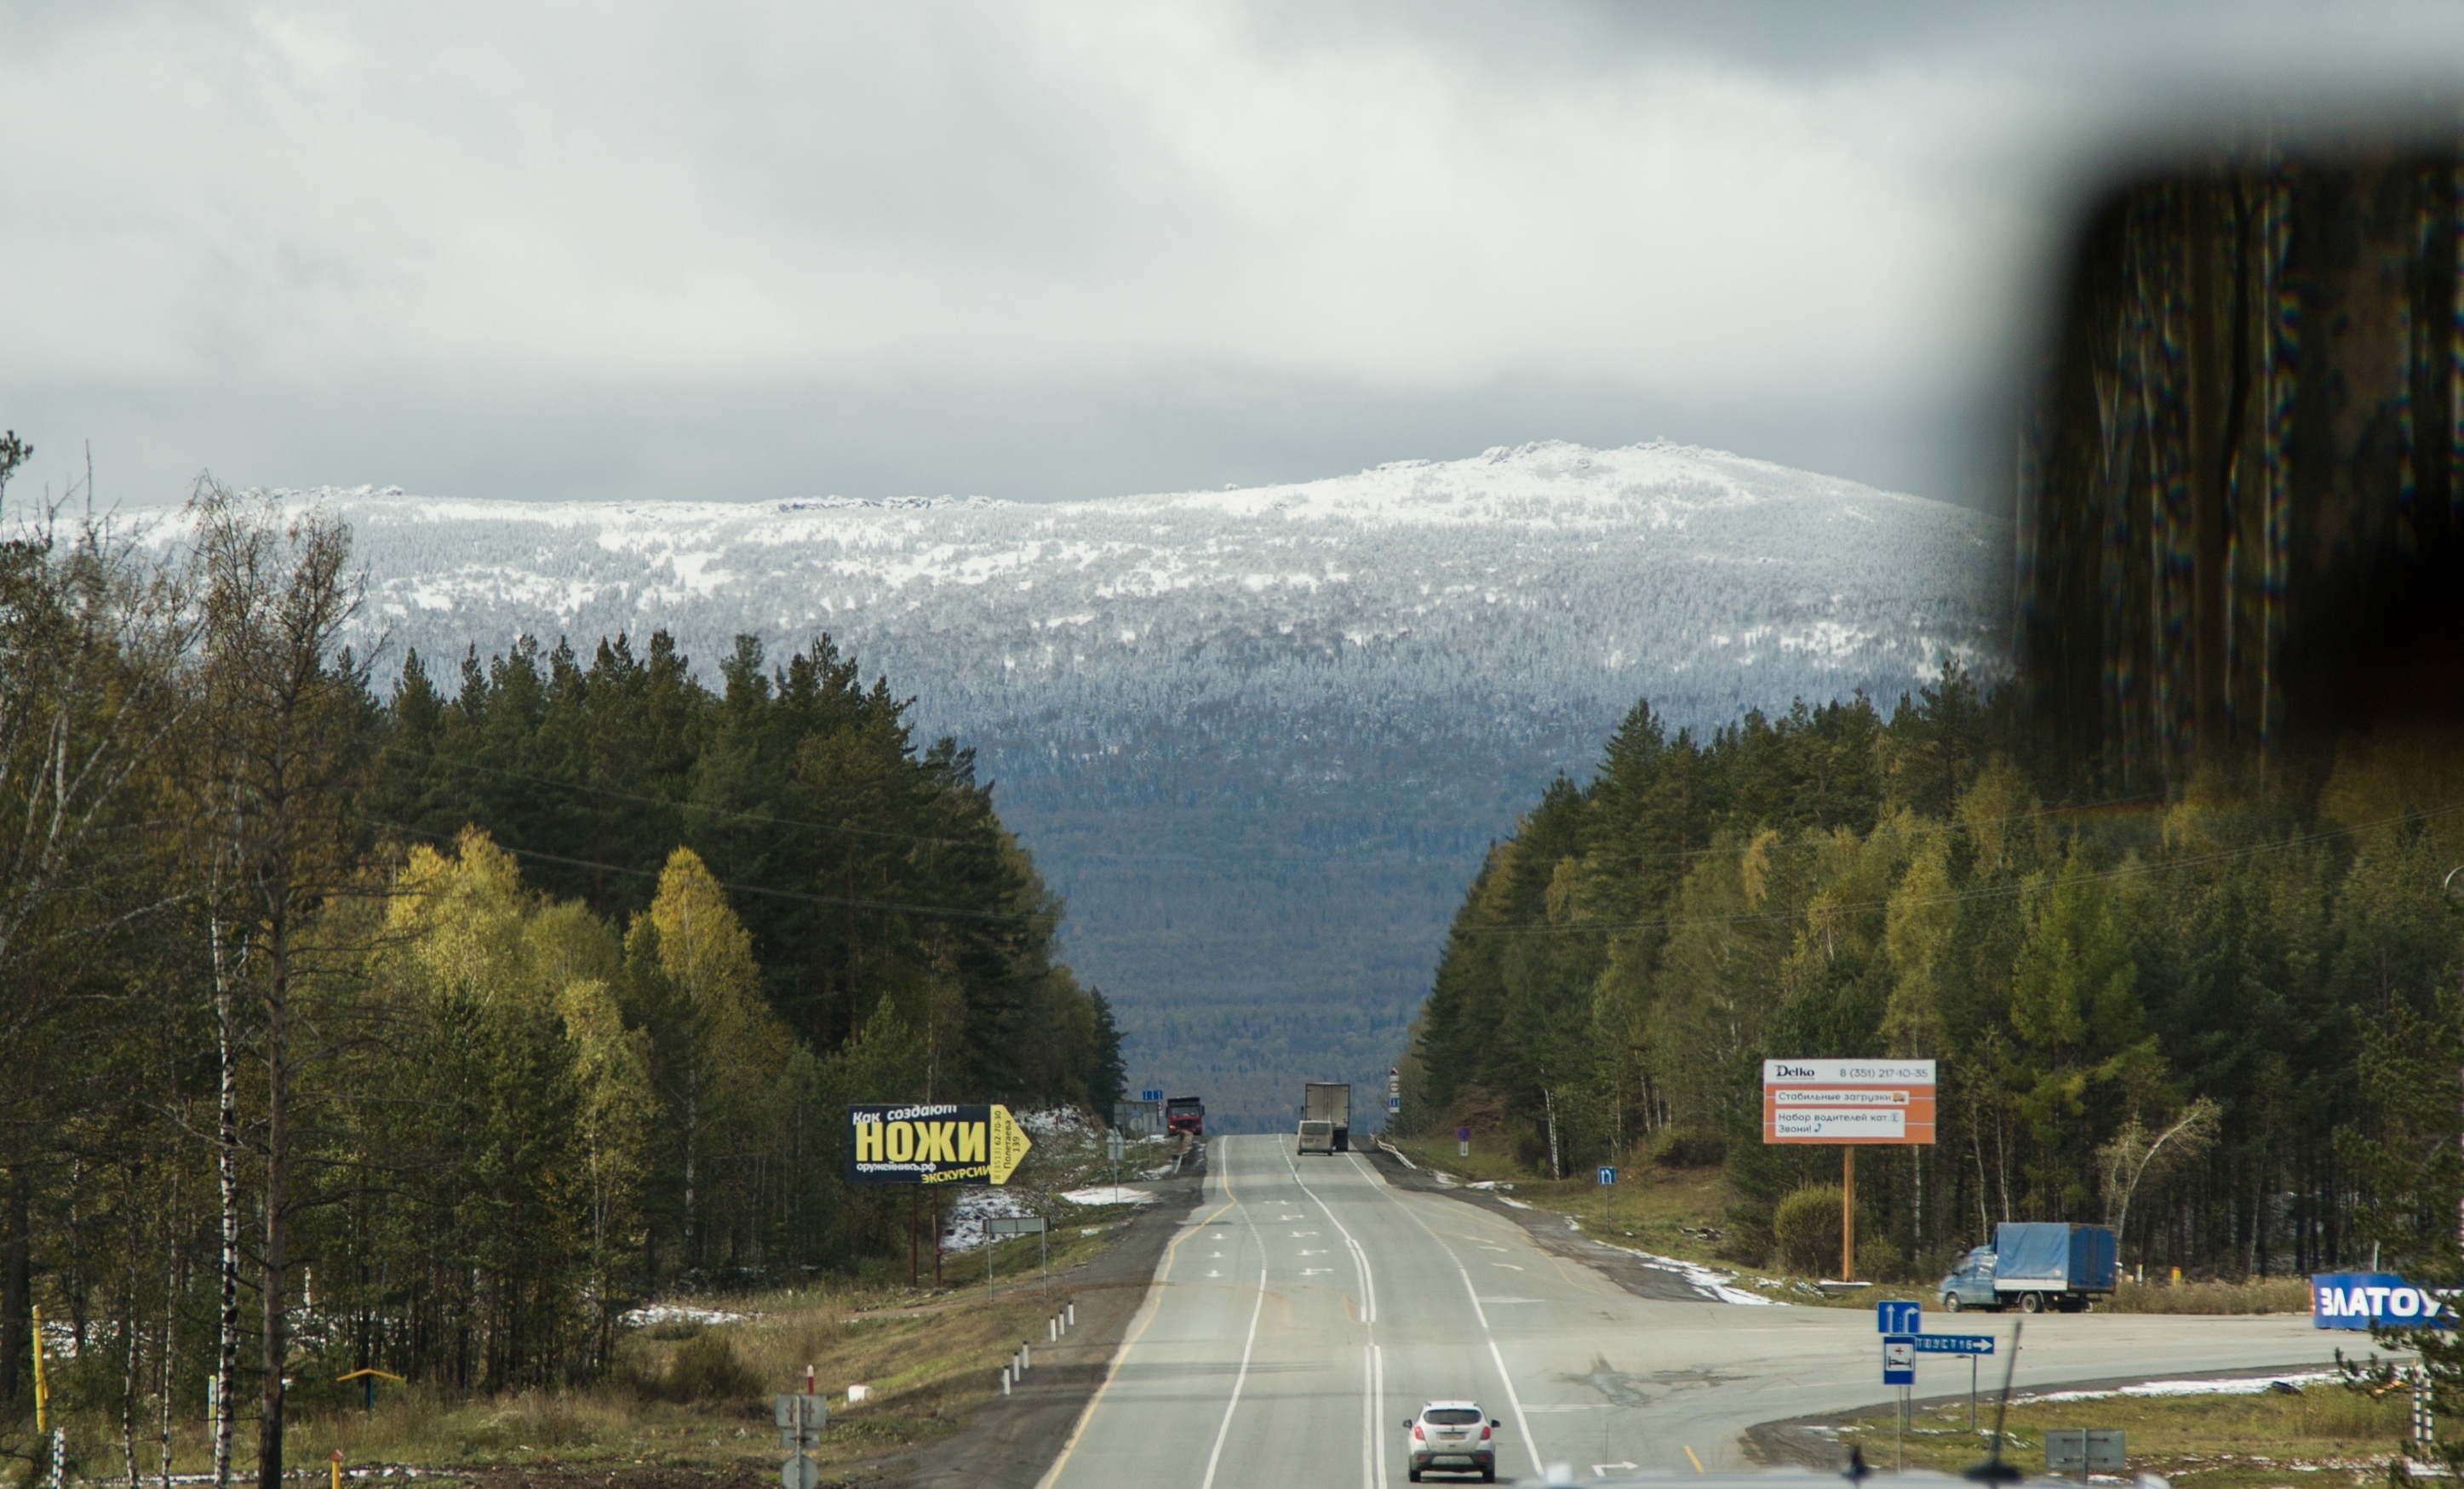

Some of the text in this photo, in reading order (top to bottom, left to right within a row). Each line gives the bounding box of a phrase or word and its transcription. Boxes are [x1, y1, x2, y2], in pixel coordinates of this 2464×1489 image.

[1774, 1064, 1815, 1077] Delko
[1839, 1068, 1928, 1079] 8 (351) 217-10-35
[1779, 1091, 1891, 1102] Стабильные загрузки
[852, 1104, 957, 1125] Как создают
[1779, 1113, 1811, 1123] Набор
[1814, 1113, 1867, 1123] водителей
[1779, 1125, 1811, 1133] Звони!
[855, 1120, 986, 1162] НОЖИ
[856, 1160, 937, 1172] оружейникъ.рф
[921, 1165, 991, 1184] ЭКСКУРСИИ
[1917, 1337, 1957, 1349] ТОУСТ
